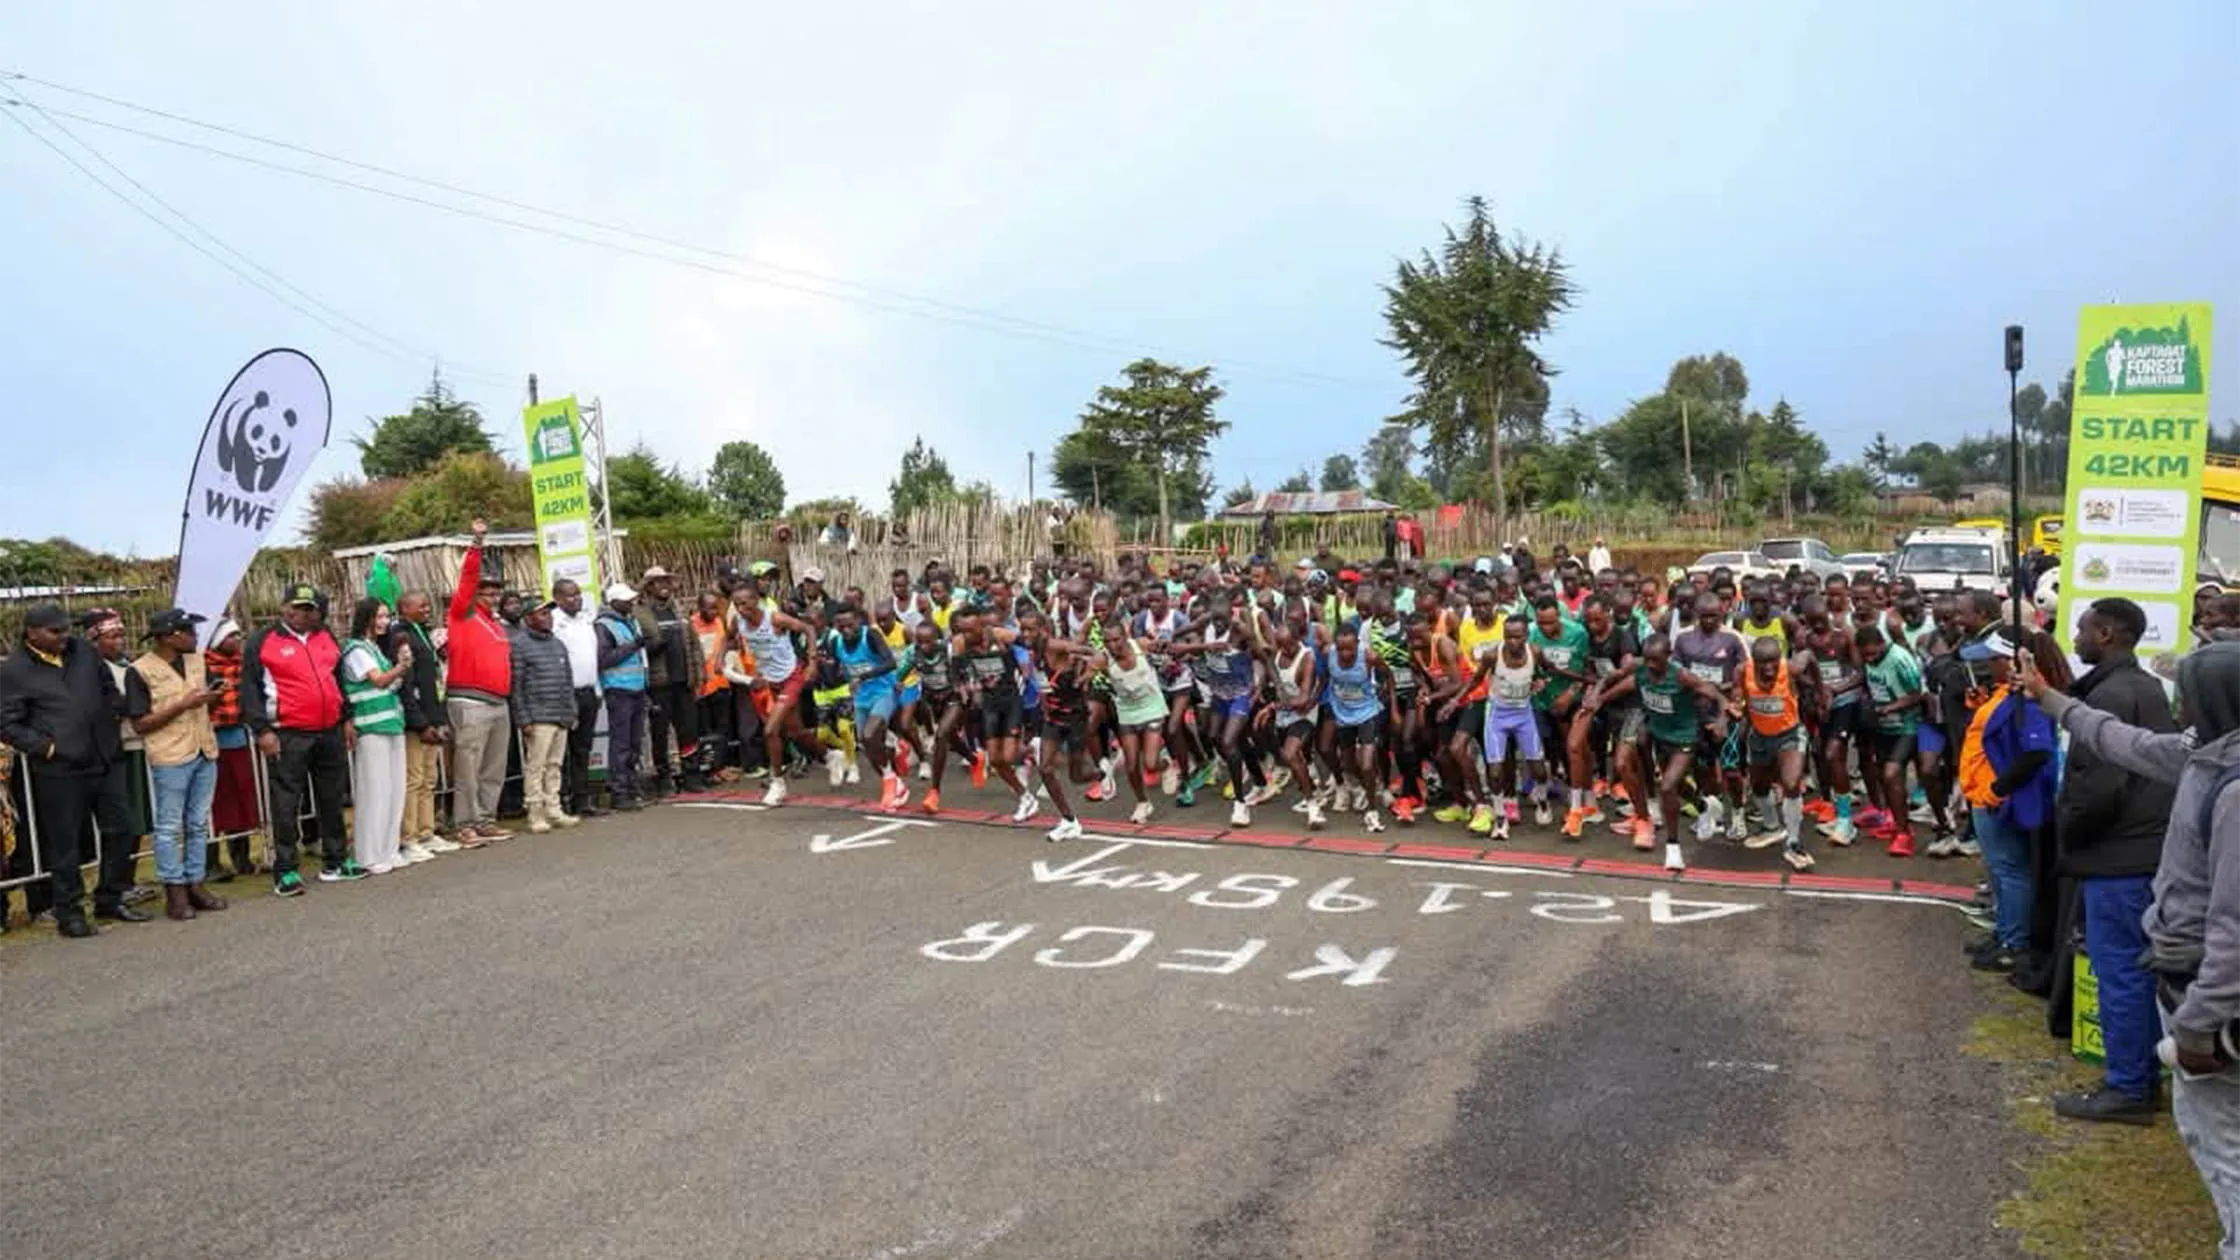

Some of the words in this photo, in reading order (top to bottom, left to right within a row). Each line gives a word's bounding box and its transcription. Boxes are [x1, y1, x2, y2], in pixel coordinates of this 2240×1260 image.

[2126, 358, 2185, 374] FOREST
[2081, 416, 2200, 441] START
[2084, 453, 2190, 478] 42KM
[536, 470, 584, 494] START
[206, 487, 276, 531] WWF
[542, 495, 585, 516] 42KM
